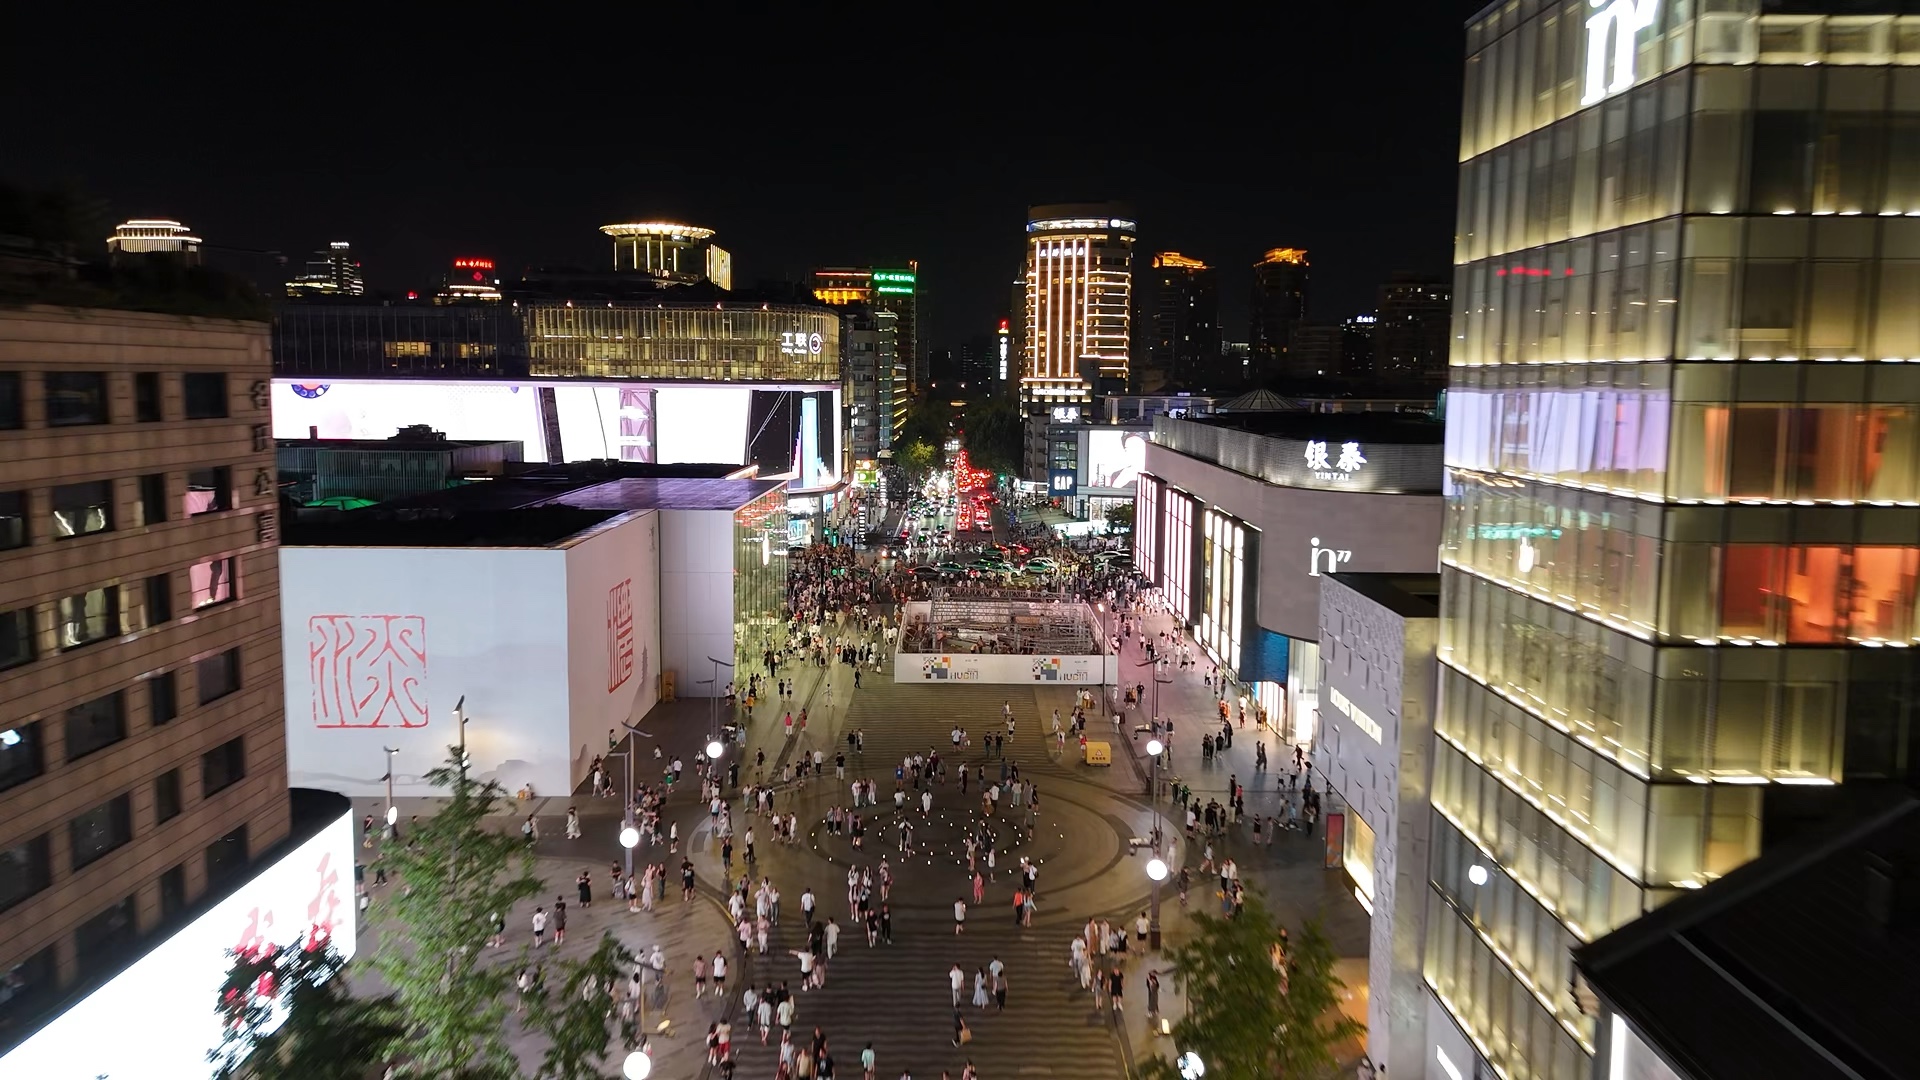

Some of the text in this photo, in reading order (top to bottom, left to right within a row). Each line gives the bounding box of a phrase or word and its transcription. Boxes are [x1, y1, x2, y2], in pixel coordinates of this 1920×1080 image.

[781, 332, 807, 347] 工联
[1304, 440, 1368, 472] 银泰
[1054, 475, 1073, 490] GAP
[1314, 471, 1350, 482] YINTAI
